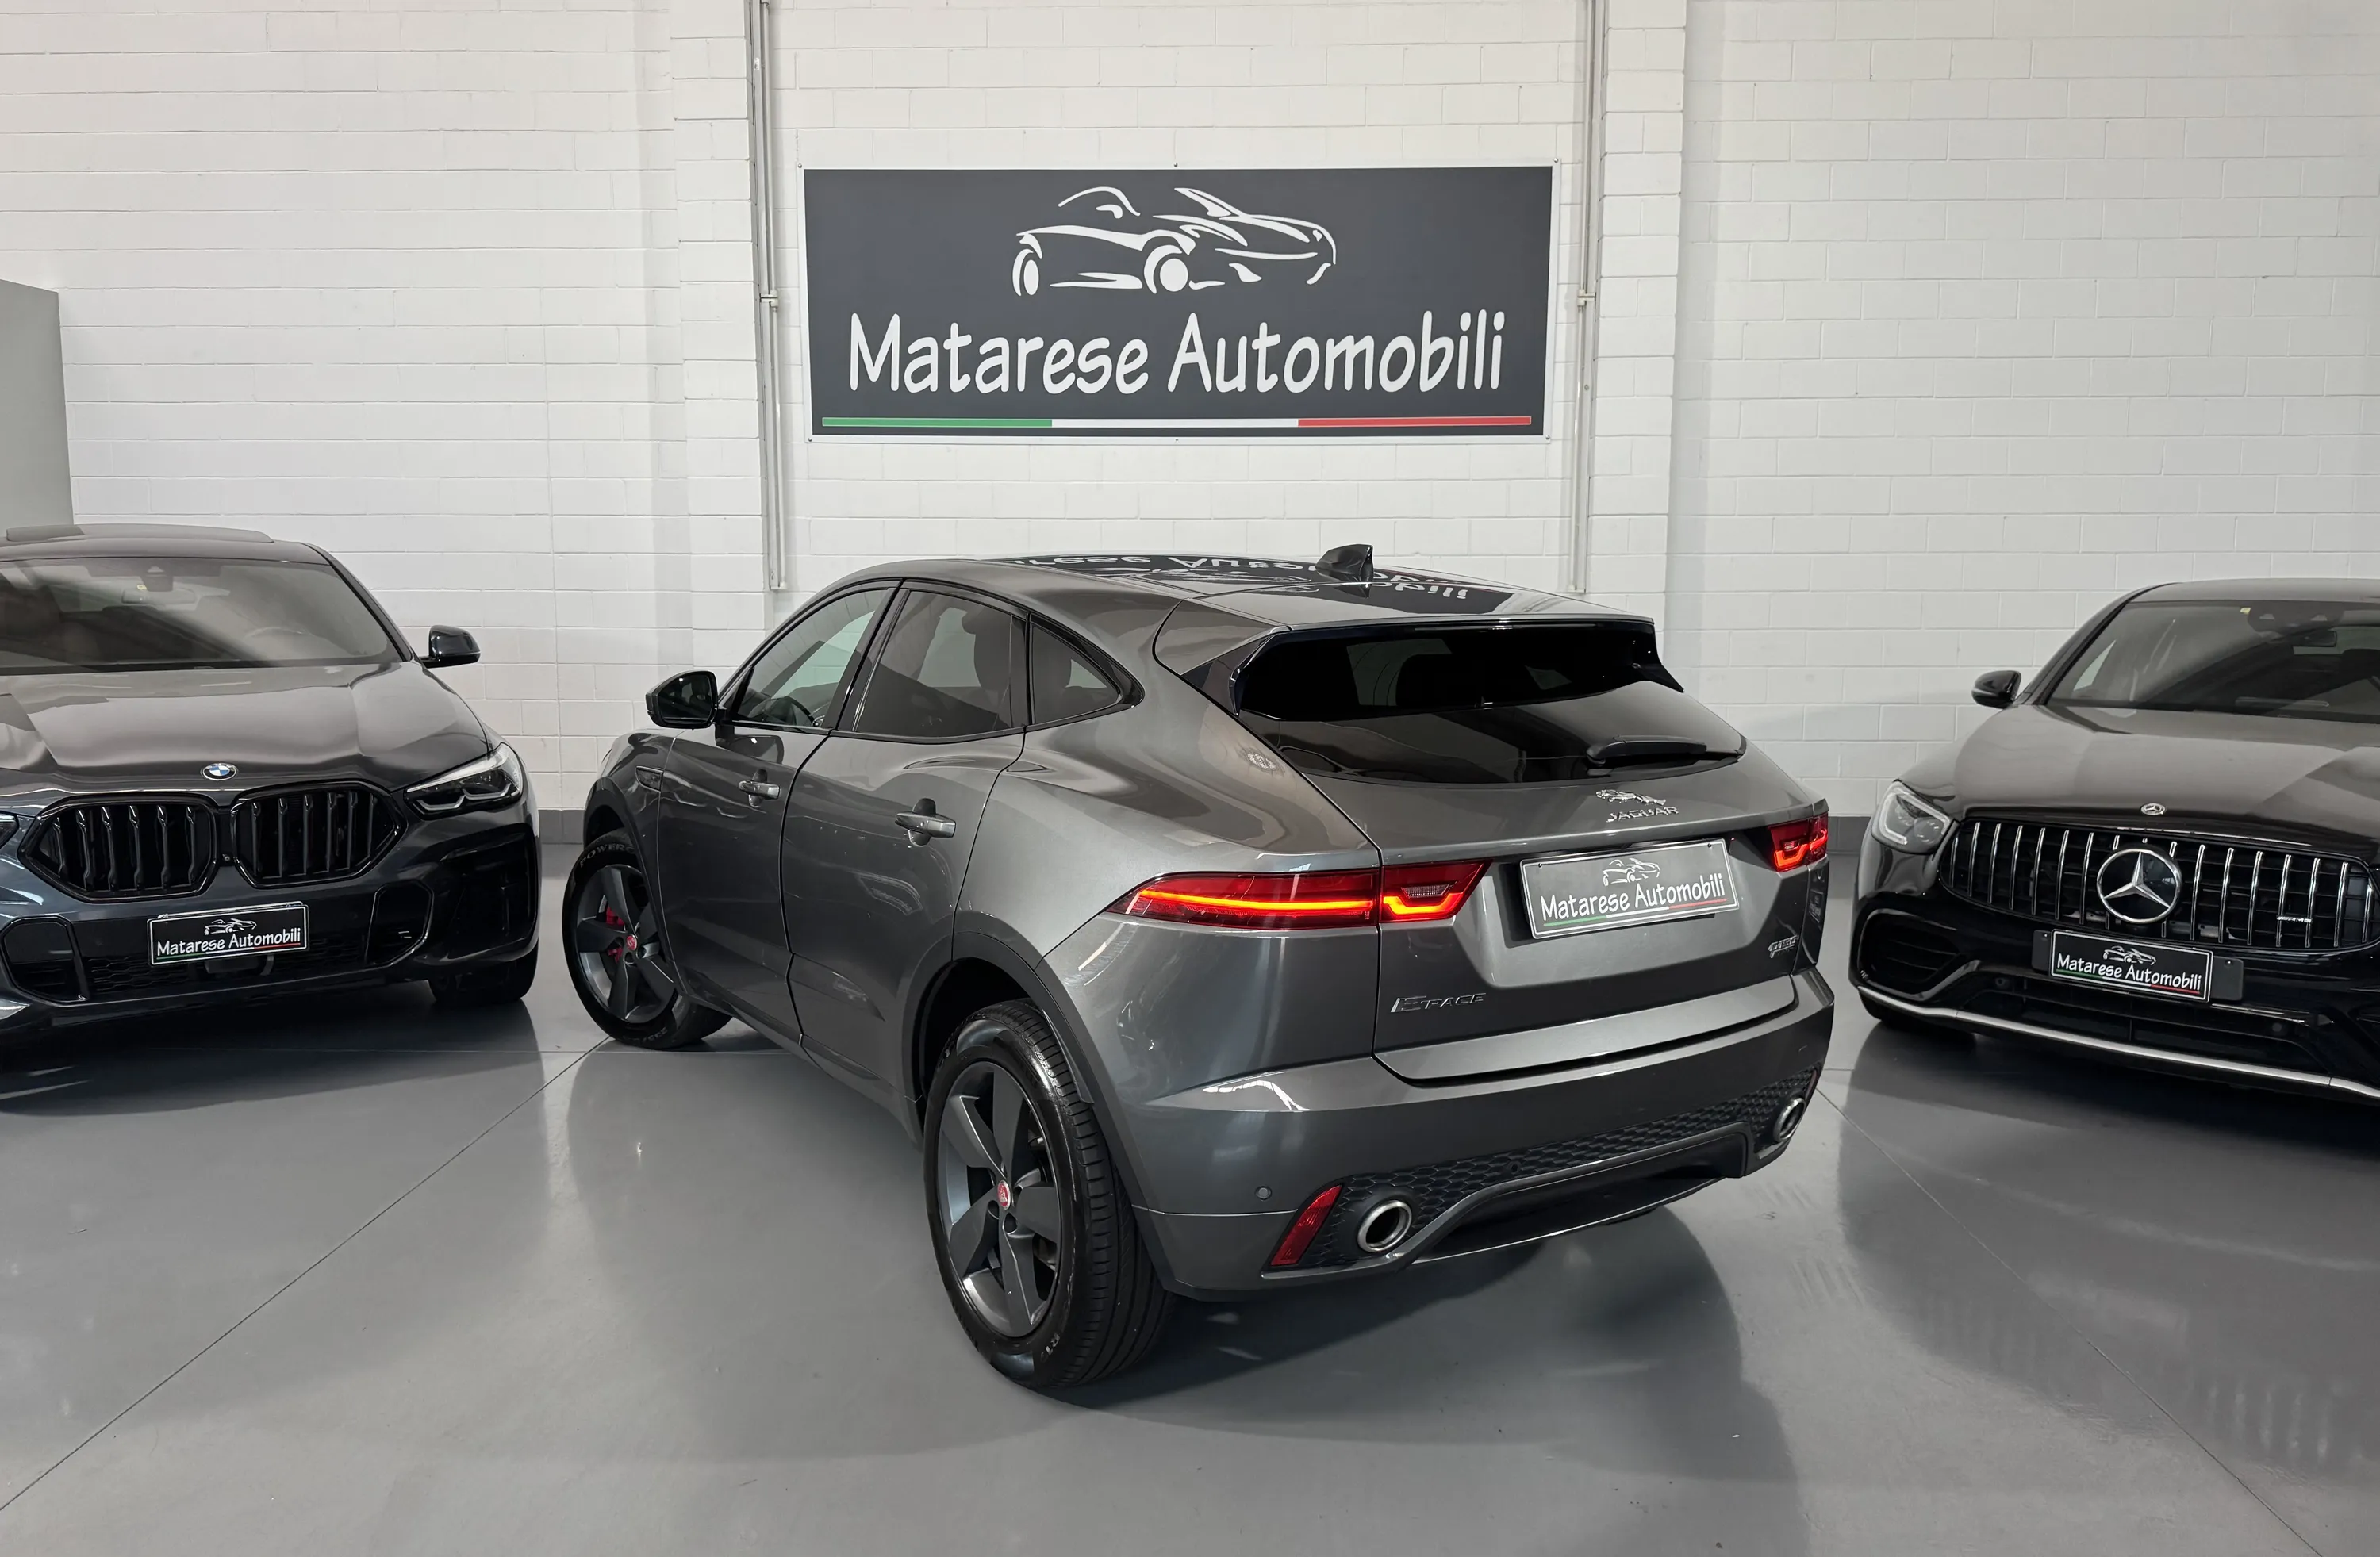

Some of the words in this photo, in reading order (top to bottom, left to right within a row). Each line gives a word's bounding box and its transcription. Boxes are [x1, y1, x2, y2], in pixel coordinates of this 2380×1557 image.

[849, 313, 1150, 394] Matarese
[1168, 308, 1505, 393] Automobili
[1606, 807, 1679, 823] JAGUAR
[1540, 892, 1630, 922] Matarese
[1634, 873, 1726, 908] Automobili
[157, 938, 225, 957] Matarese
[228, 927, 301, 949] Automobili
[2057, 953, 2123, 978] Matarese
[2125, 964, 2202, 991] Automobili
